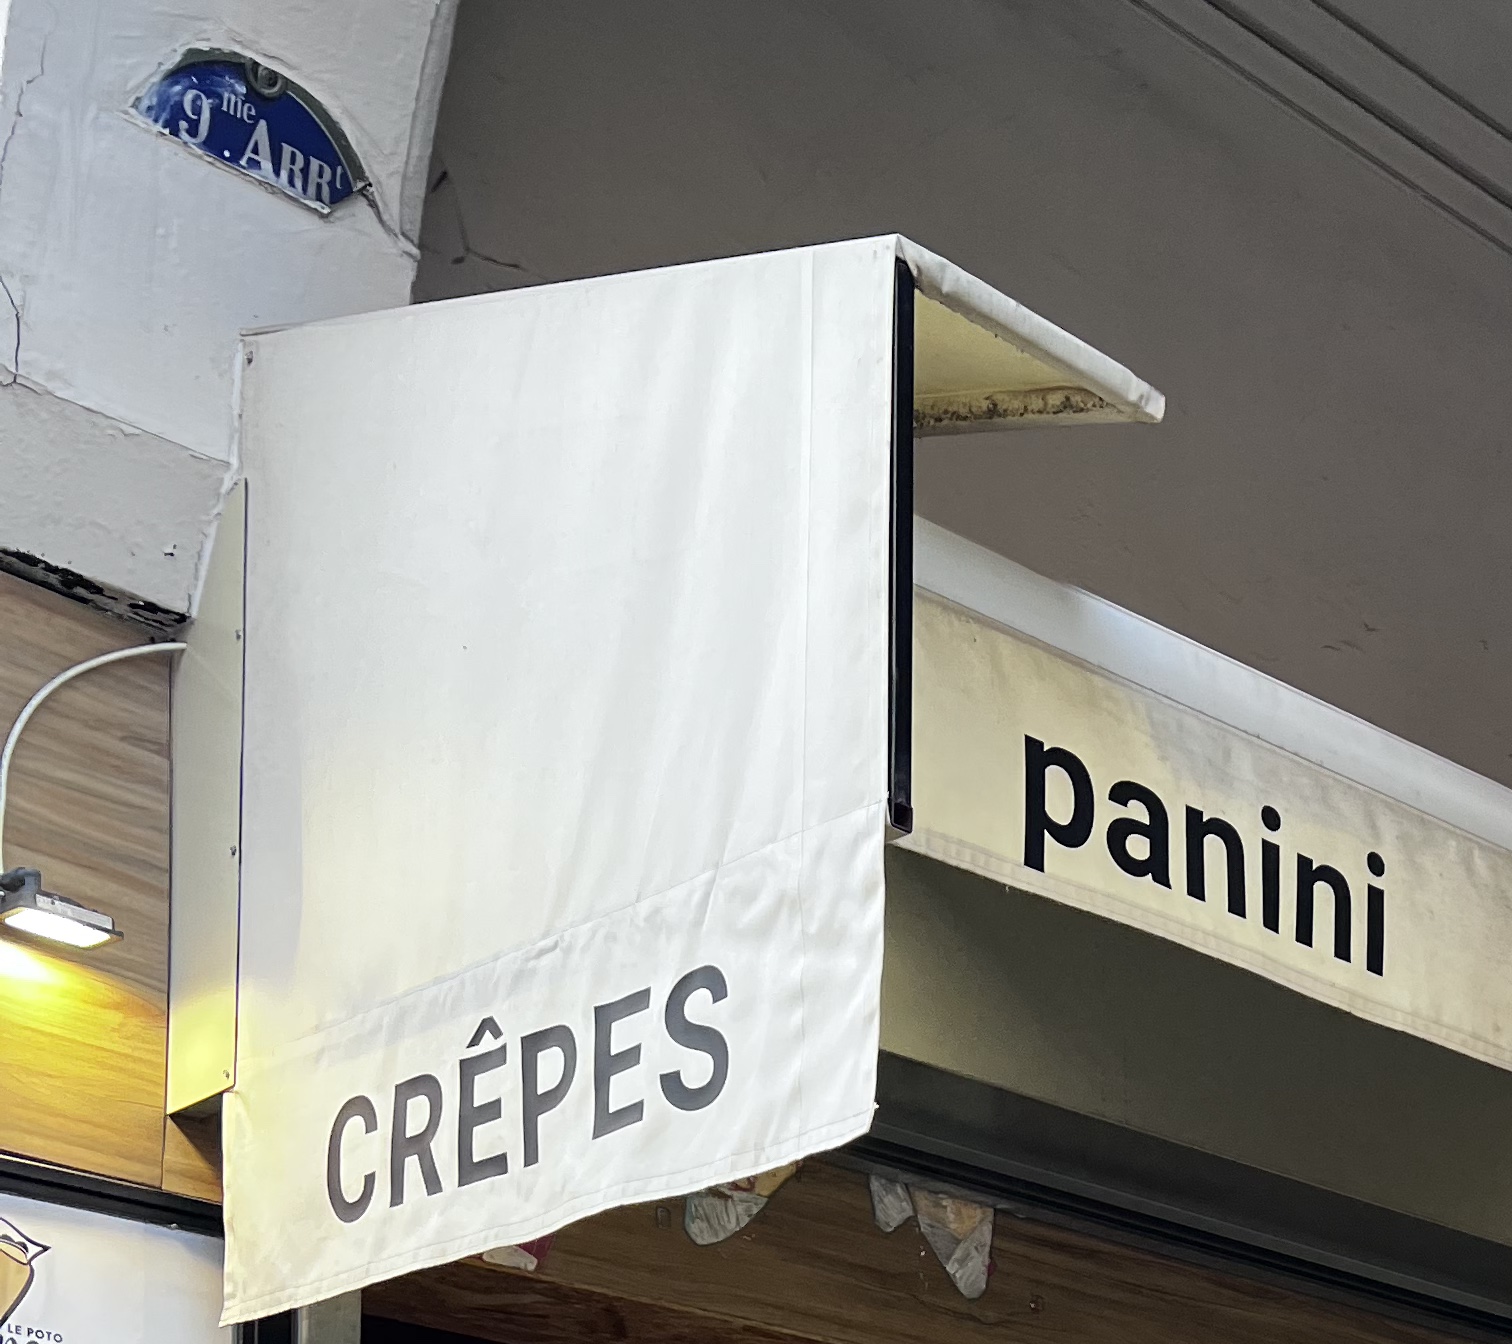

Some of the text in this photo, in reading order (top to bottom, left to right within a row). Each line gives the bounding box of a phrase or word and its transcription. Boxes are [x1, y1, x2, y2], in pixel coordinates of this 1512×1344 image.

[1023, 733, 1386, 977] panini
[327, 964, 729, 1224] CRÊPES
[7, 1323, 63, 1343] LE POTO
